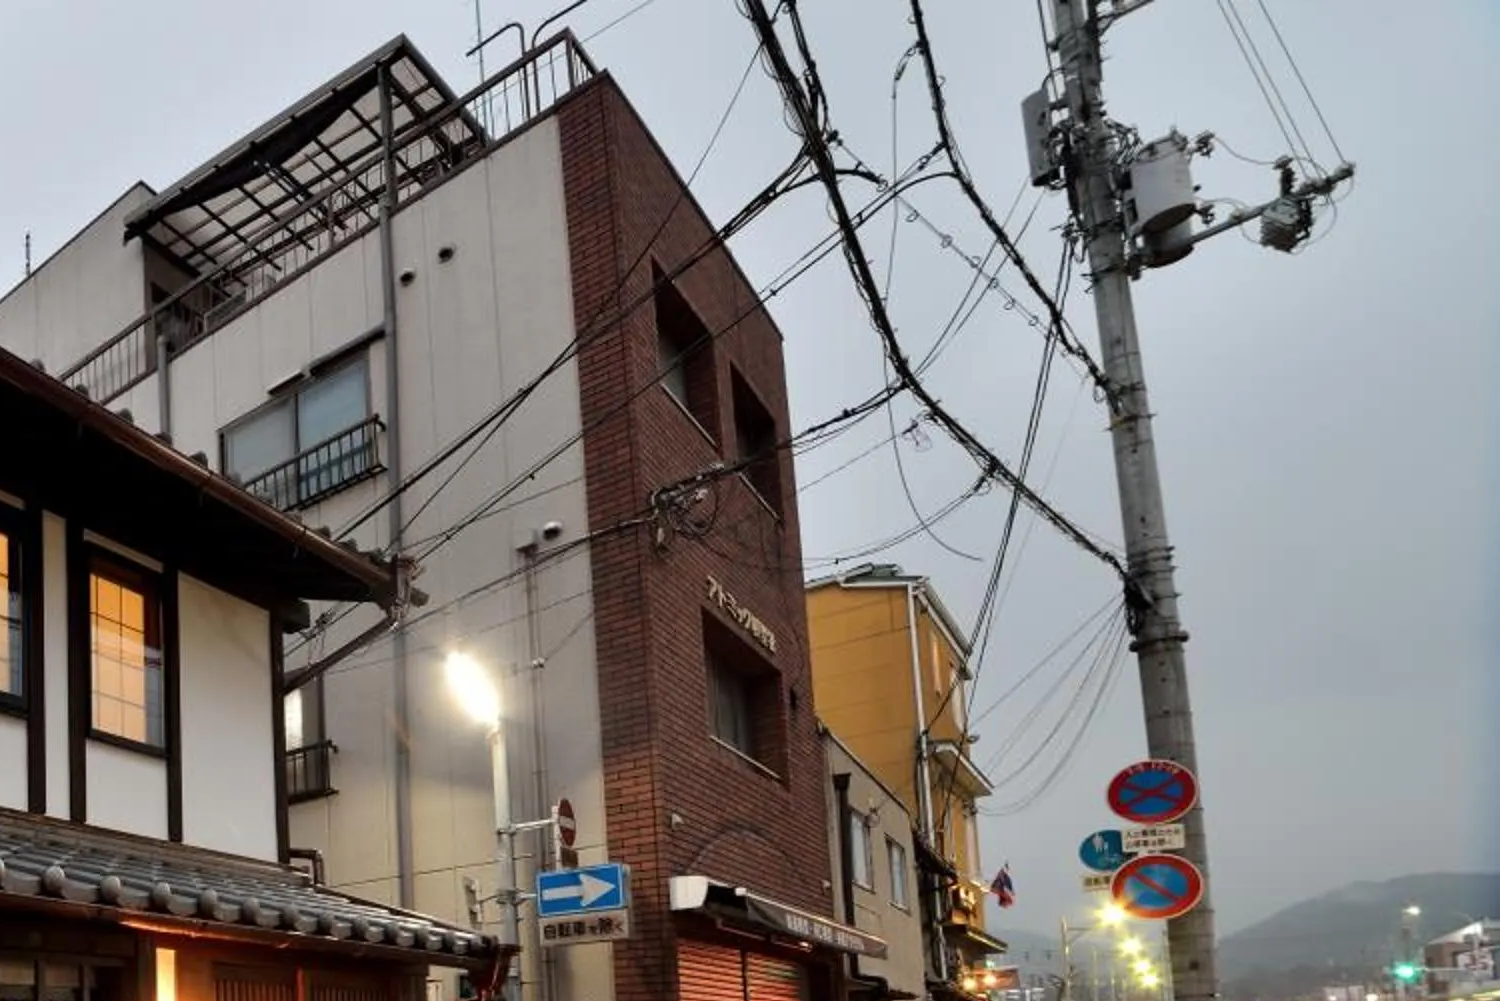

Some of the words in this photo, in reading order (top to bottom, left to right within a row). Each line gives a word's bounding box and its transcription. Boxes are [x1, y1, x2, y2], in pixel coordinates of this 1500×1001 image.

[544, 918, 624, 940] 自転車を除く
